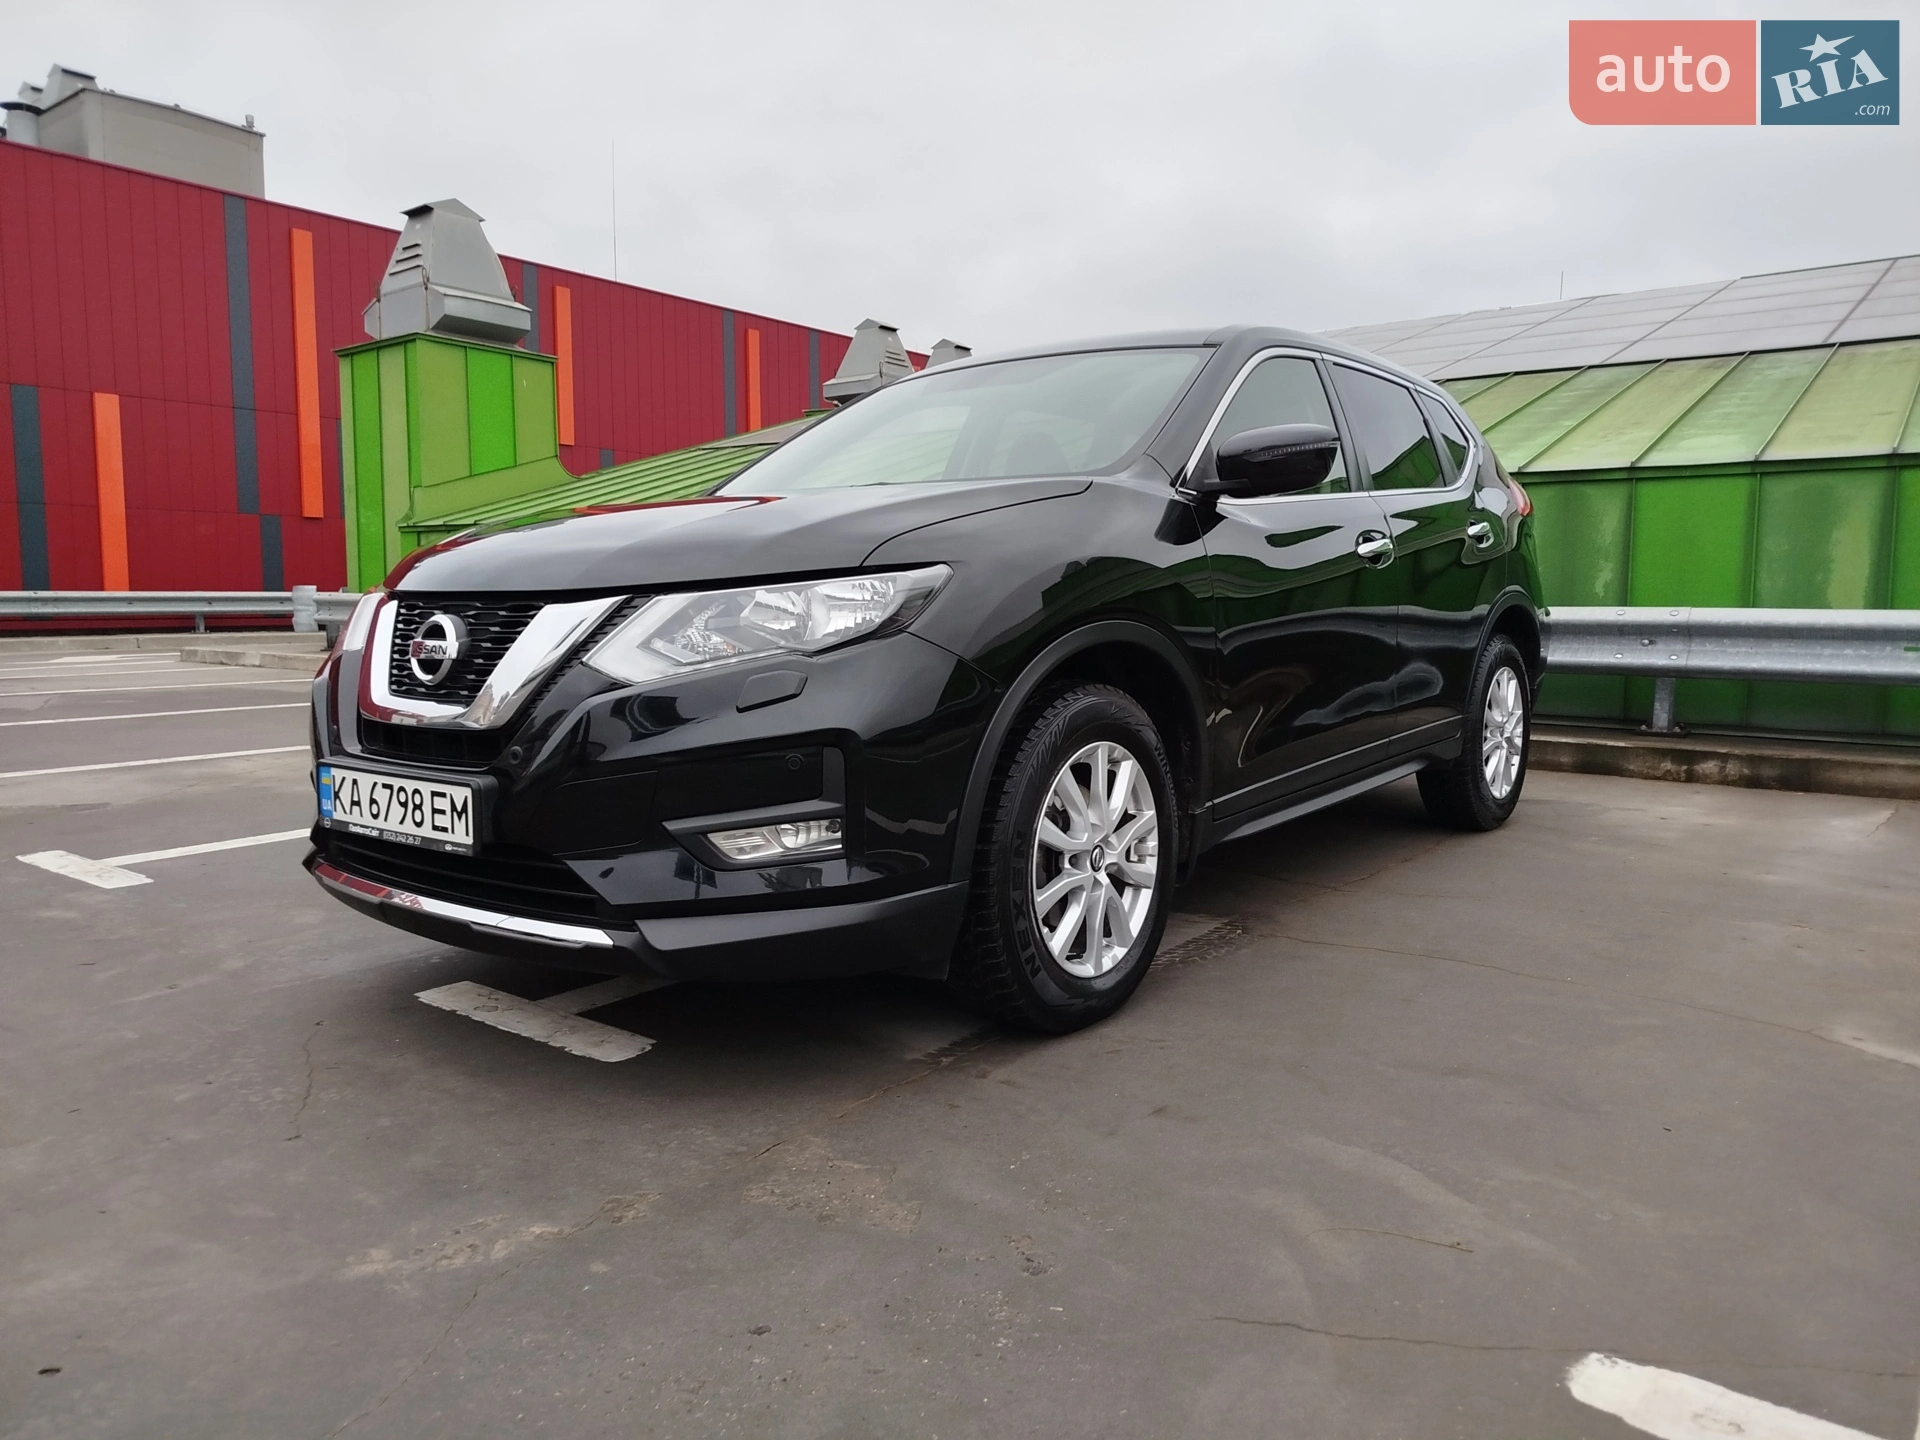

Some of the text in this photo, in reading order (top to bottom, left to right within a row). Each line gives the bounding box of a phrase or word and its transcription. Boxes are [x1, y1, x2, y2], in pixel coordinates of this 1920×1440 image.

[412, 644, 448, 655] SSAN
[322, 798, 332, 812] UA
[332, 774, 470, 837] KA 6798 EM
[1011, 829, 1042, 980] NEXEN
